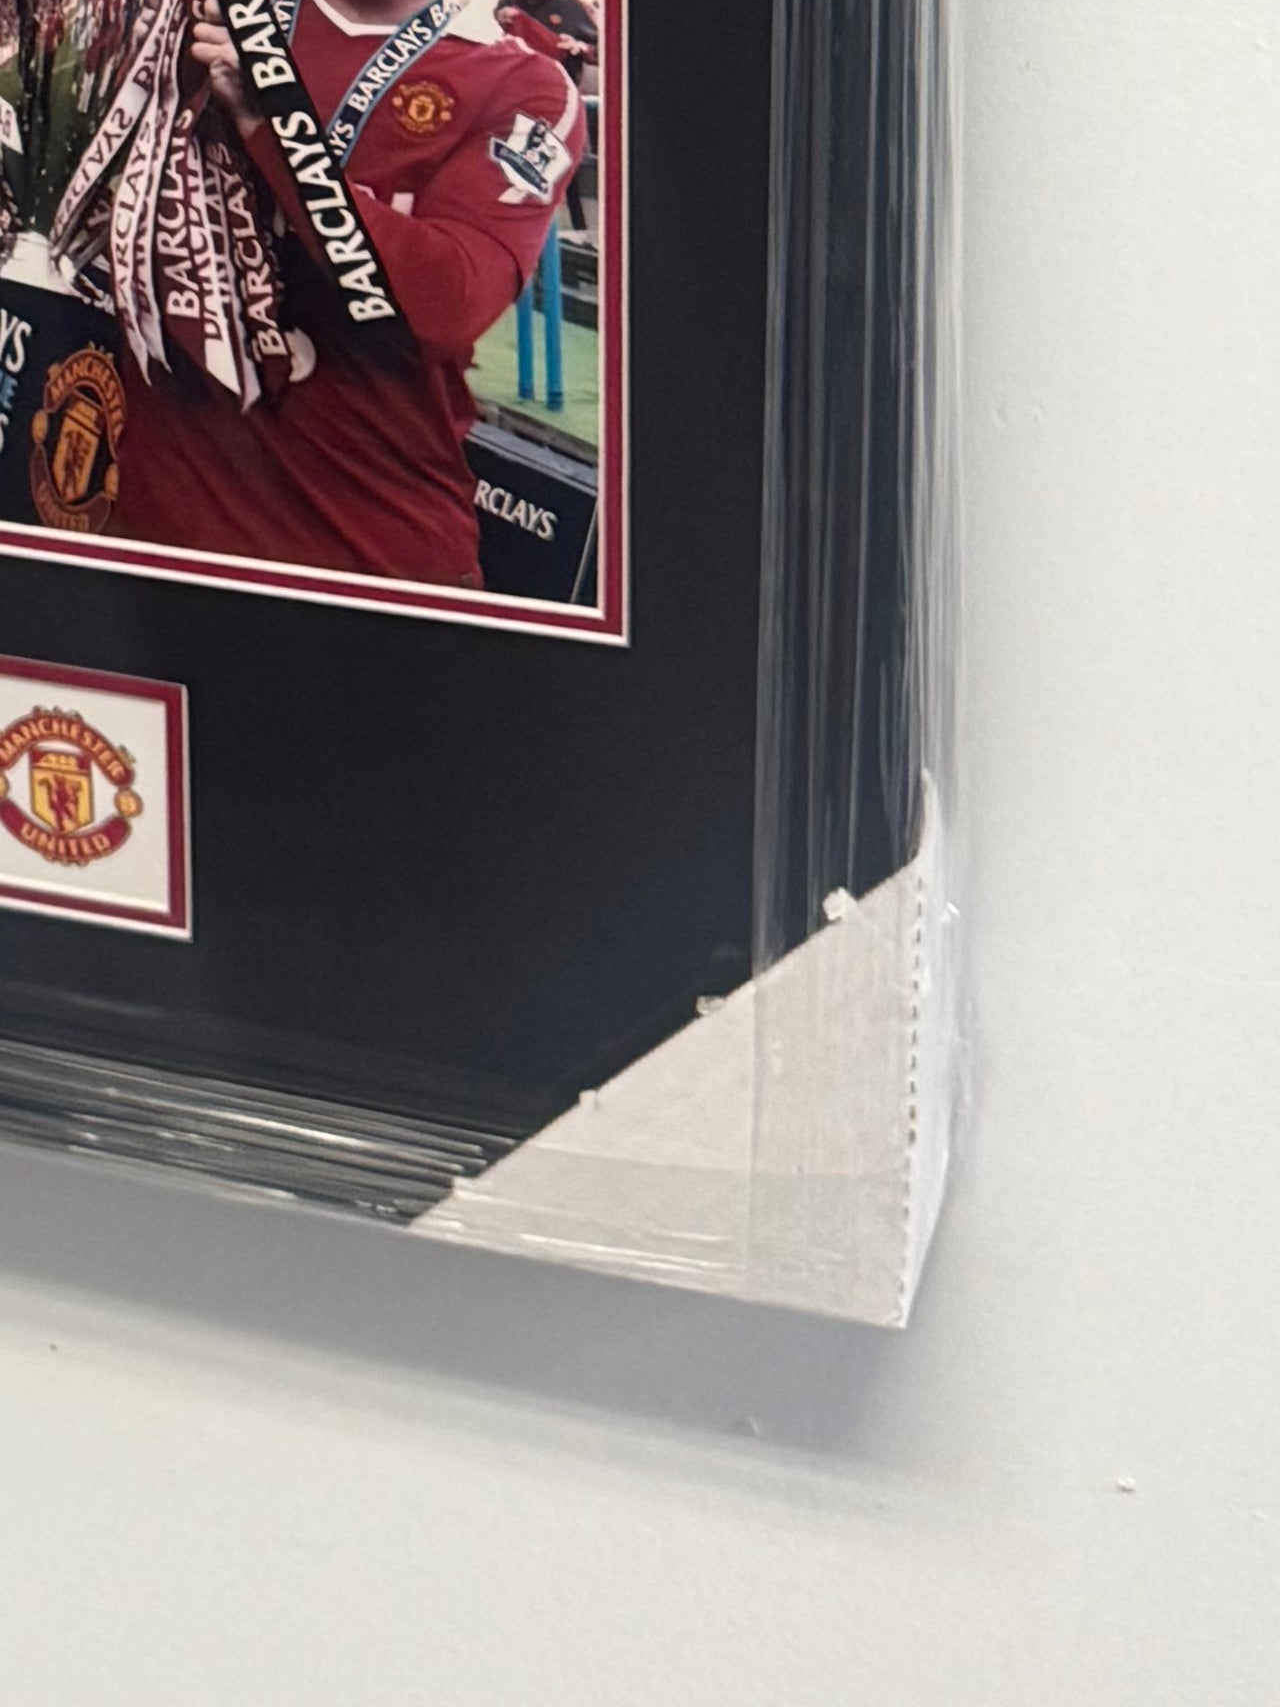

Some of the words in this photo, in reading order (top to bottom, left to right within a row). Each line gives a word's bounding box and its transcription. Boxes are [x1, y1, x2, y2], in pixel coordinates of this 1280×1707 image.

[347, 18, 433, 114] BARCLAYS
[269, 110, 397, 324] BARCLAYS
[473, 478, 559, 542] RCLAYS
[19, 821, 111, 858] UNITED
